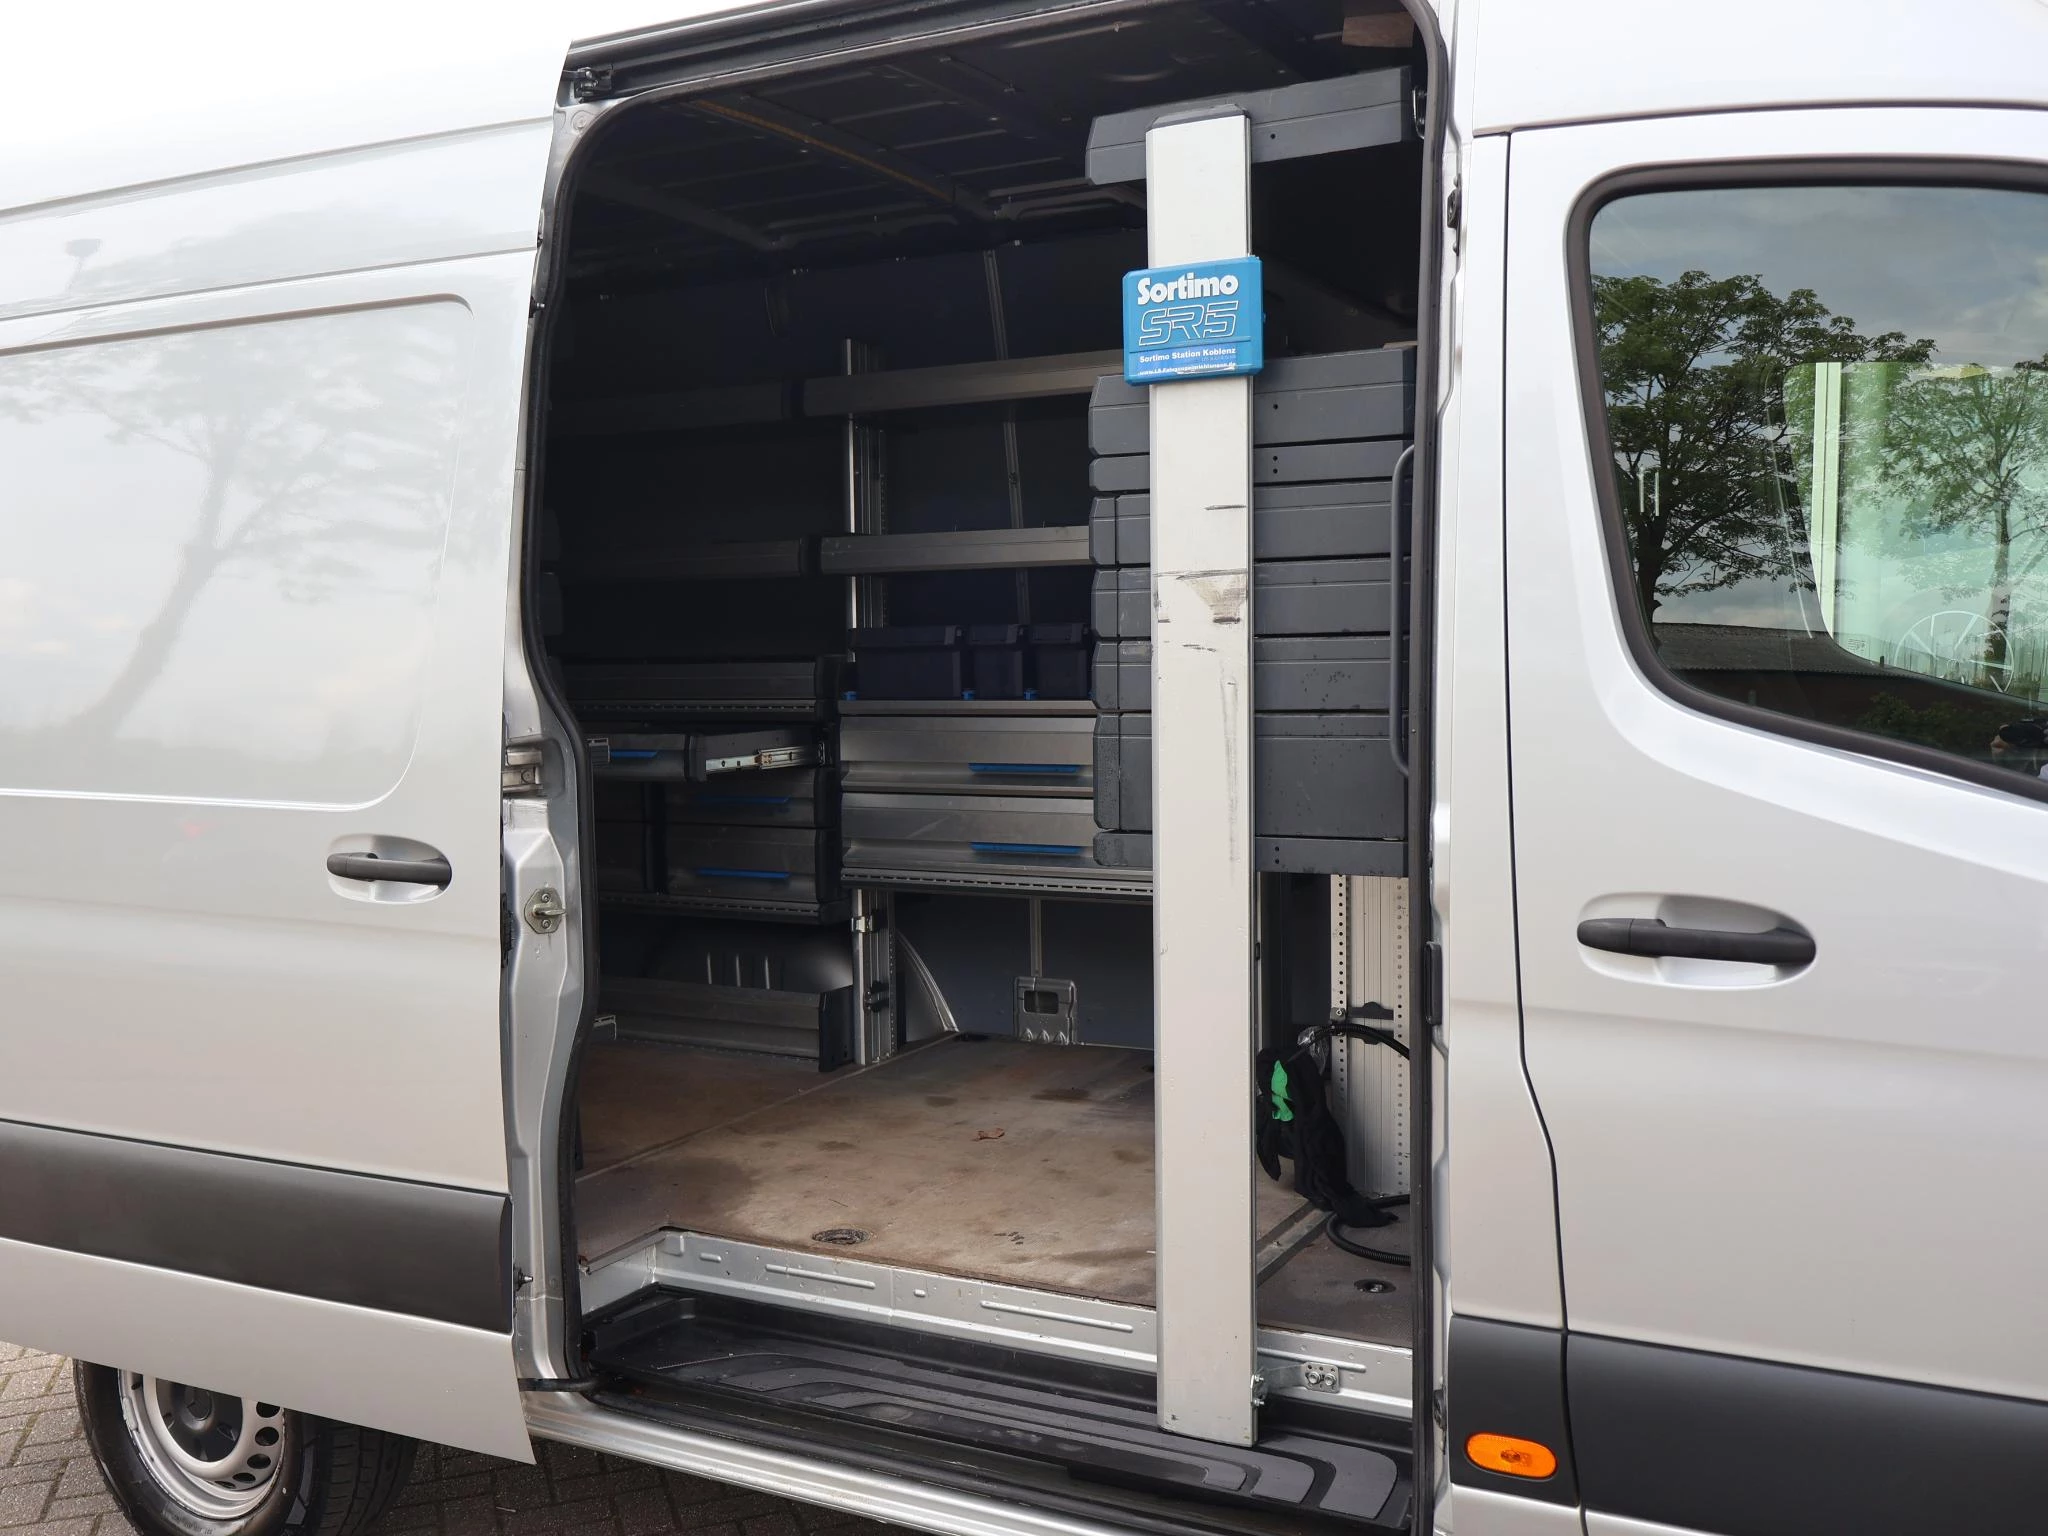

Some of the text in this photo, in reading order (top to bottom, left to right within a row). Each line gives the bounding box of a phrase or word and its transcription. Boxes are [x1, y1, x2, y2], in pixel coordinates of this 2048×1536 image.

[1137, 272, 1239, 305] Sortimo
[1139, 355, 1170, 363] Sortimo
[1172, 351, 1201, 360] Station
[1202, 347, 1236, 356] Koblenz
